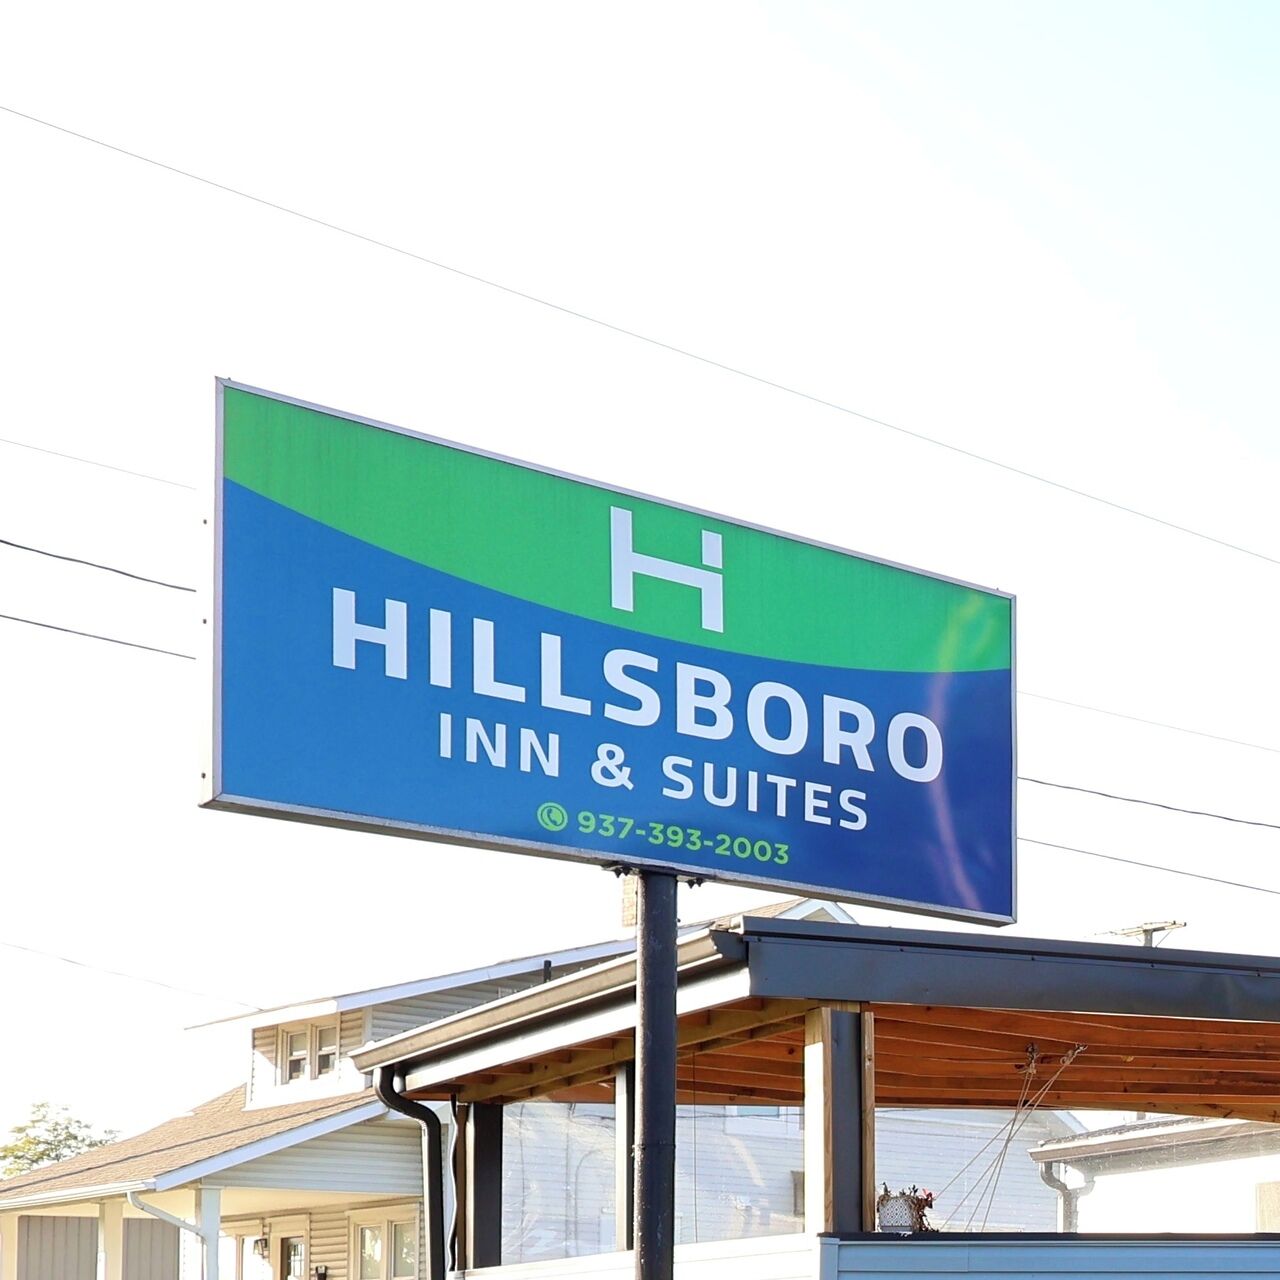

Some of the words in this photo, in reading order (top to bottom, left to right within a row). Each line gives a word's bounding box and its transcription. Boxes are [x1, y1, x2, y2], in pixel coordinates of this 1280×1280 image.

[610, 506, 724, 633] H
[333, 587, 944, 783] HILLSBORO
[440, 713, 560, 778] INN
[590, 743, 634, 790] &
[662, 755, 868, 831] SUITES
[577, 810, 790, 865] 937-393-2003
